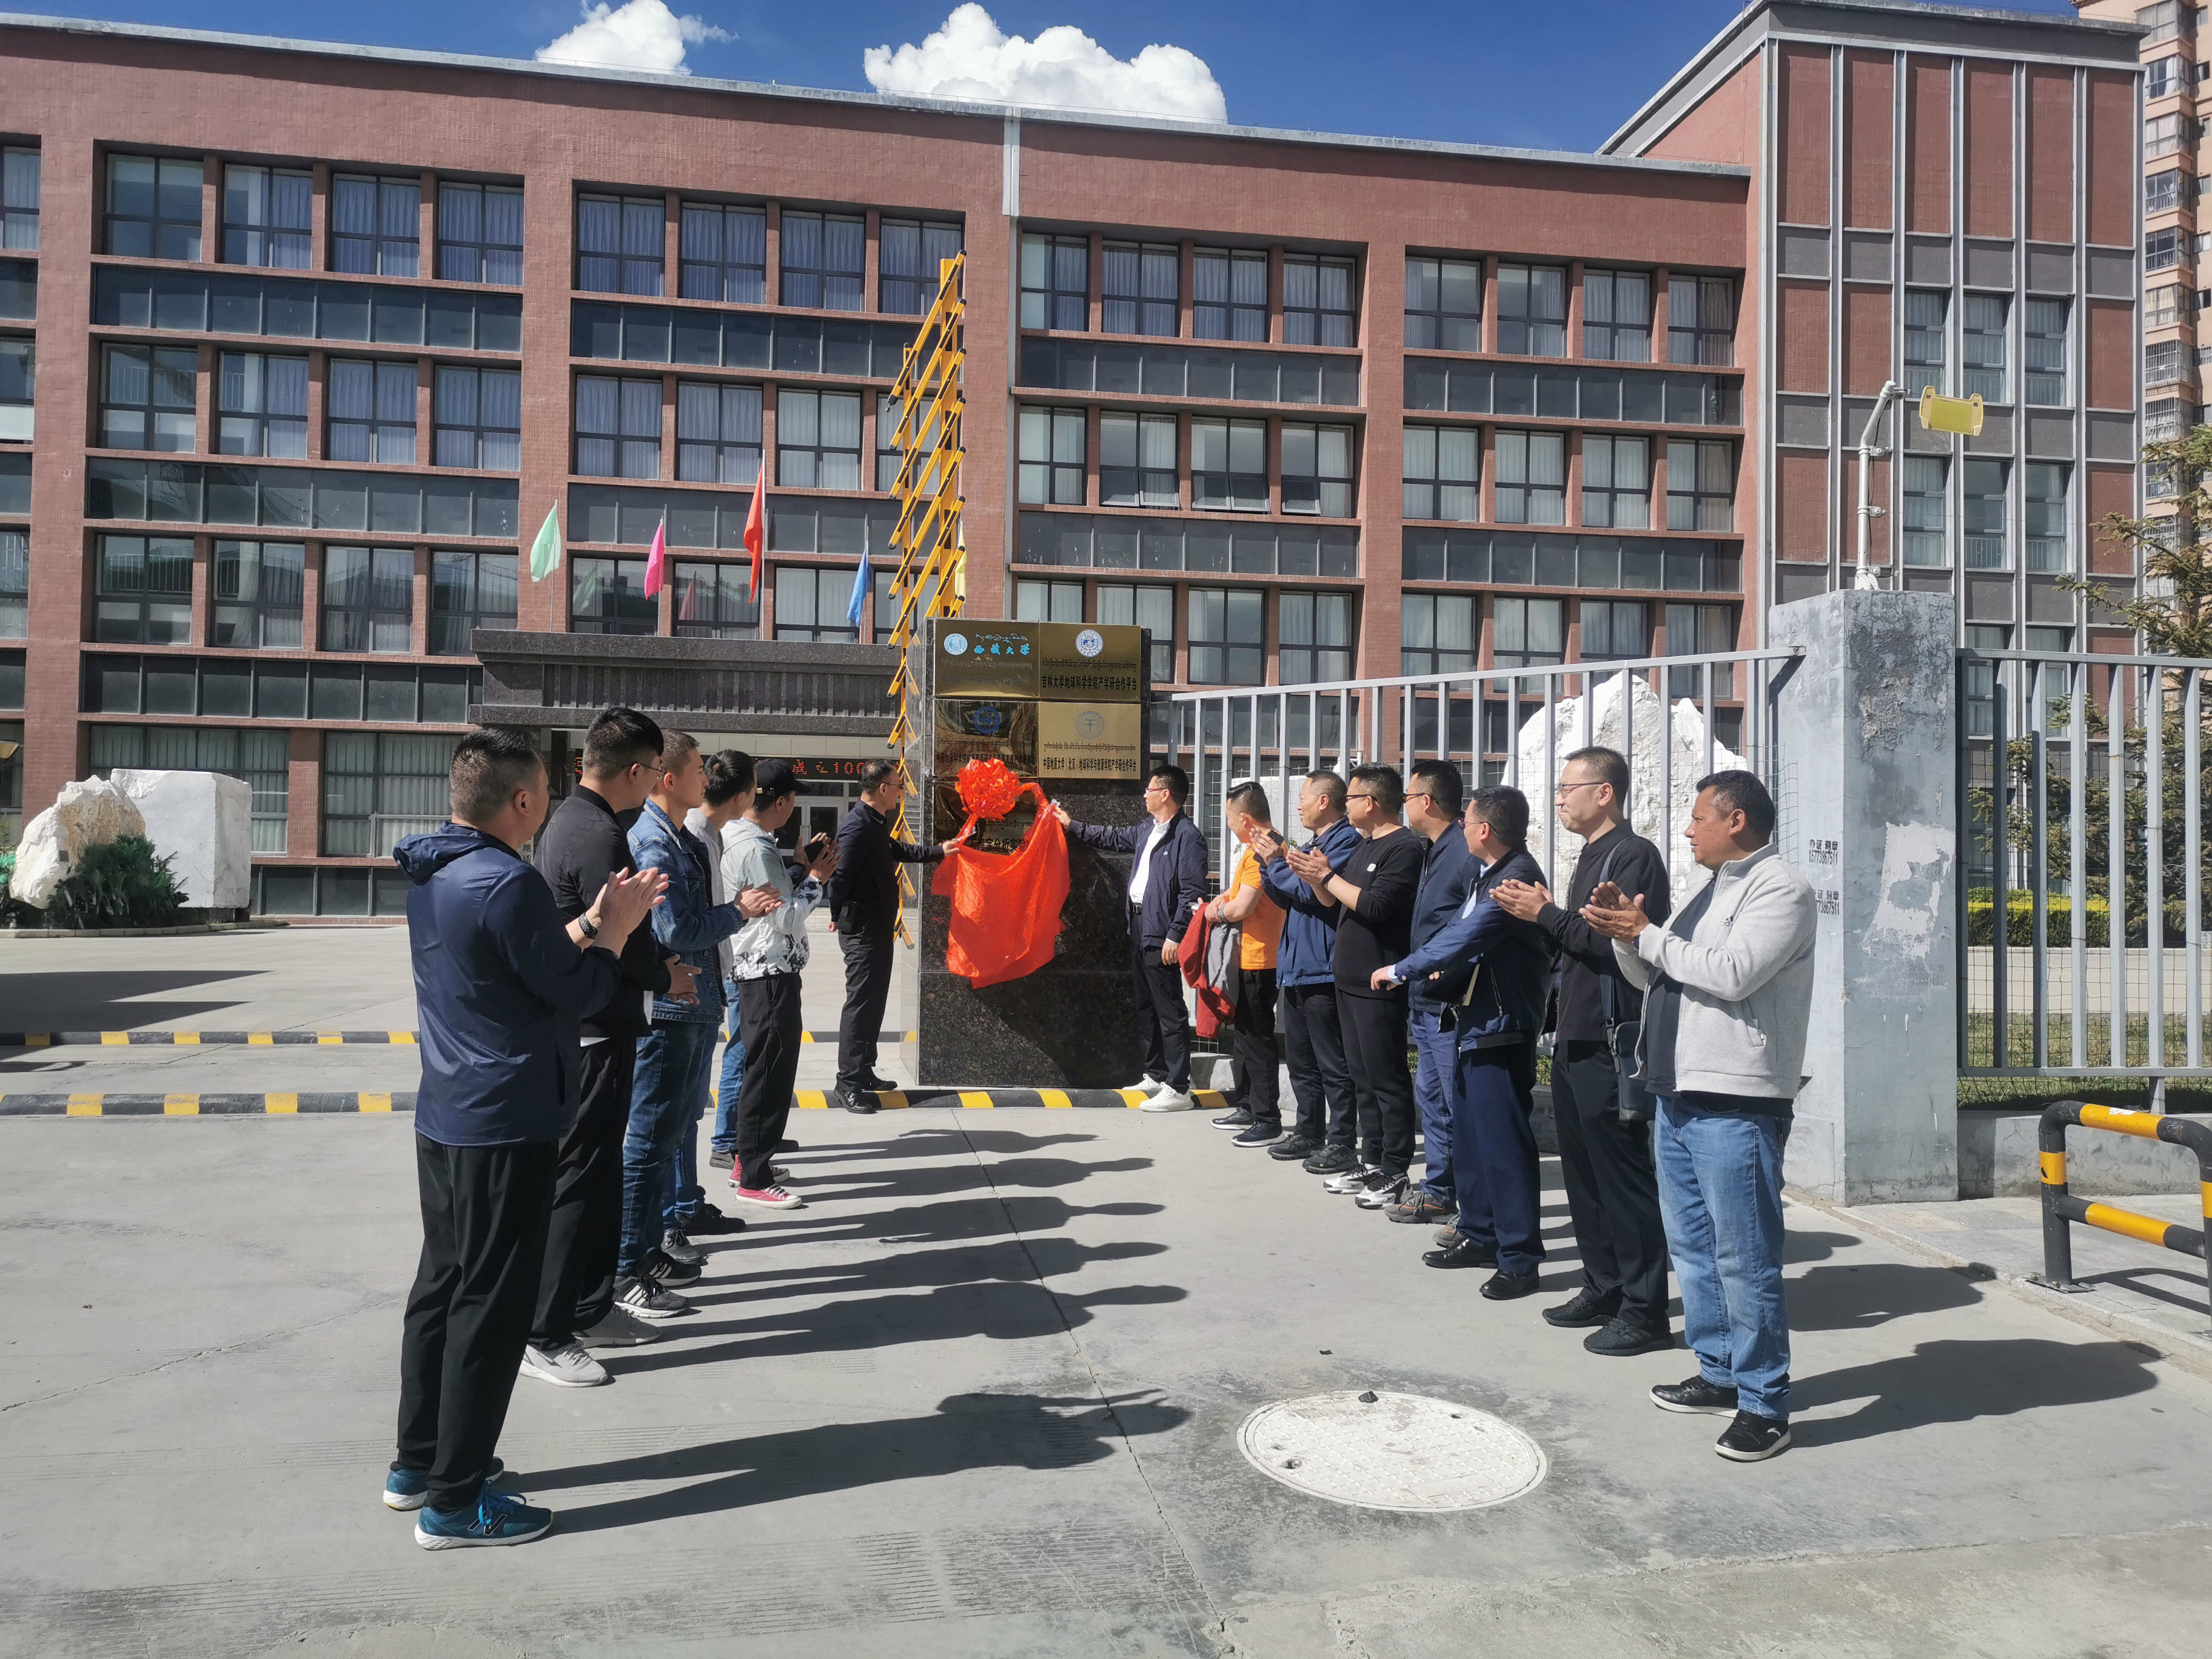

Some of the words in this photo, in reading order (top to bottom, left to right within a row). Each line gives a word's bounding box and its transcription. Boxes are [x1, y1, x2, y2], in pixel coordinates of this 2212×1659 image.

[1042, 674, 1137, 691] 吉林大学地球科学学院产学研合作平台
